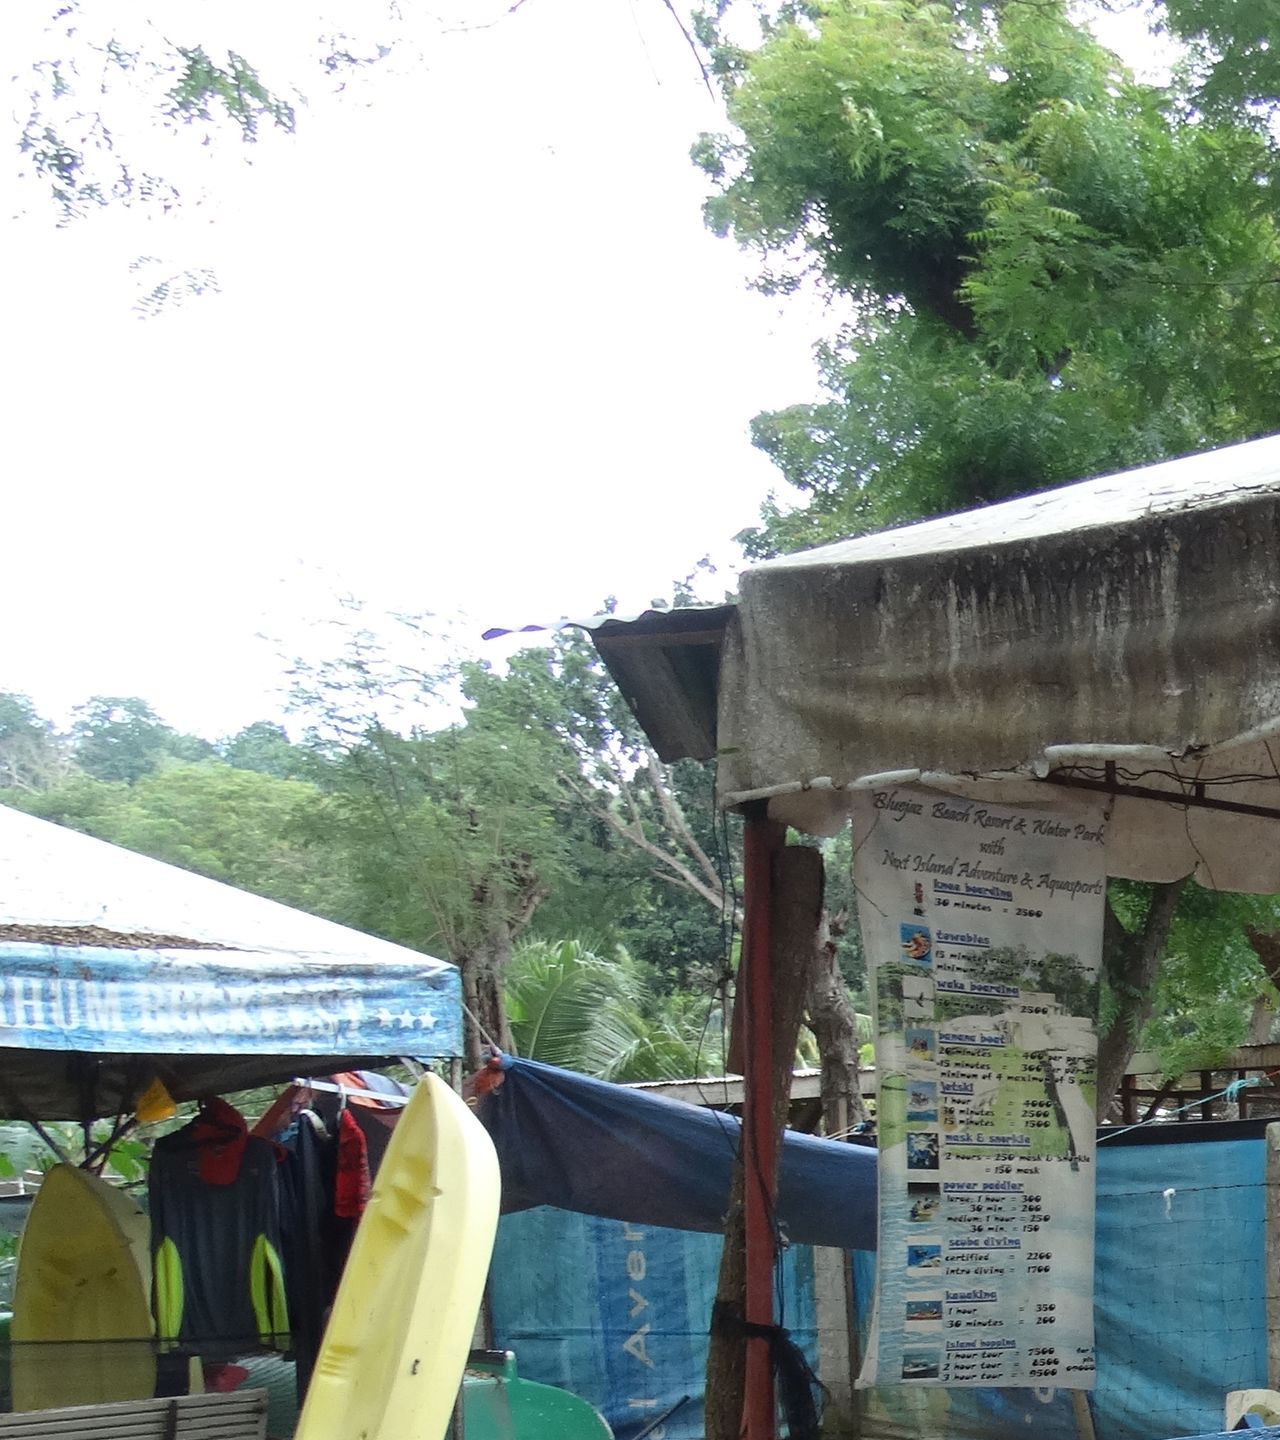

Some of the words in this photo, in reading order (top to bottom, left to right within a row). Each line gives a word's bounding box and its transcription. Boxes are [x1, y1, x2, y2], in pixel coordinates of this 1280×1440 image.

[932, 801, 975, 823] Beach
[973, 810, 1016, 830] Resort
[1013, 818, 1028, 835] &
[1033, 820, 1070, 838] Water
[1074, 823, 1105, 845] Park
[979, 837, 1005, 856] with
[882, 850, 909, 870] Next
[913, 854, 959, 876] Island
[958, 860, 1018, 885] Adventure
[1020, 872, 1033, 889] &
[1036, 873, 1103, 900] Aquasports
[933, 879, 961, 891] knee
[965, 882, 1013, 898] boarding
[934, 898, 949, 907] 30
[953, 902, 992, 912] minutes
[1015, 908, 1043, 918] 2500
[937, 980, 965, 990] wake
[970, 981, 1019, 994] boarding
[1020, 1005, 1048, 1015] 2500
[939, 1032, 976, 1043] banana
[980, 1033, 1006, 1044] boat
[954, 1050, 992, 1058] minutes
[954, 1062, 991, 1070] minutes
[940, 1071, 978, 1079] minimum
[940, 1082, 974, 1092] jetski
[959, 1119, 995, 1127] minutes
[1024, 1120, 1050, 1128] 1500
[945, 1134, 973, 1142] mask
[945, 1153, 951, 1161] 2
[995, 1153, 1015, 1161] 250
[1019, 1154, 1043, 1162] mask
[995, 1165, 1011, 1174] 150
[943, 1182, 978, 1192] power
[1022, 1195, 1042, 1203] 300
[1021, 1205, 1042, 1213] 200
[970, 1225, 983, 1233] 30
[1022, 1225, 1040, 1233] 150
[949, 1237, 979, 1247] scuba
[984, 1236, 1020, 1247] diving
[945, 1253, 990, 1262] certified
[1027, 1252, 1052, 1261] 2200
[974, 1267, 1005, 1276] diving
[1027, 1266, 1050, 1274] 1700
[956, 1307, 977, 1315] hour
[1035, 1304, 1056, 1312] 350
[948, 1320, 961, 1328] 30
[966, 1319, 1004, 1328] minutes
[1035, 1316, 1056, 1325] 200
[946, 1339, 977, 1349] island
[980, 1338, 1016, 1348] hopping
[981, 1351, 1003, 1359] tour
[981, 1372, 1003, 1380] tour
